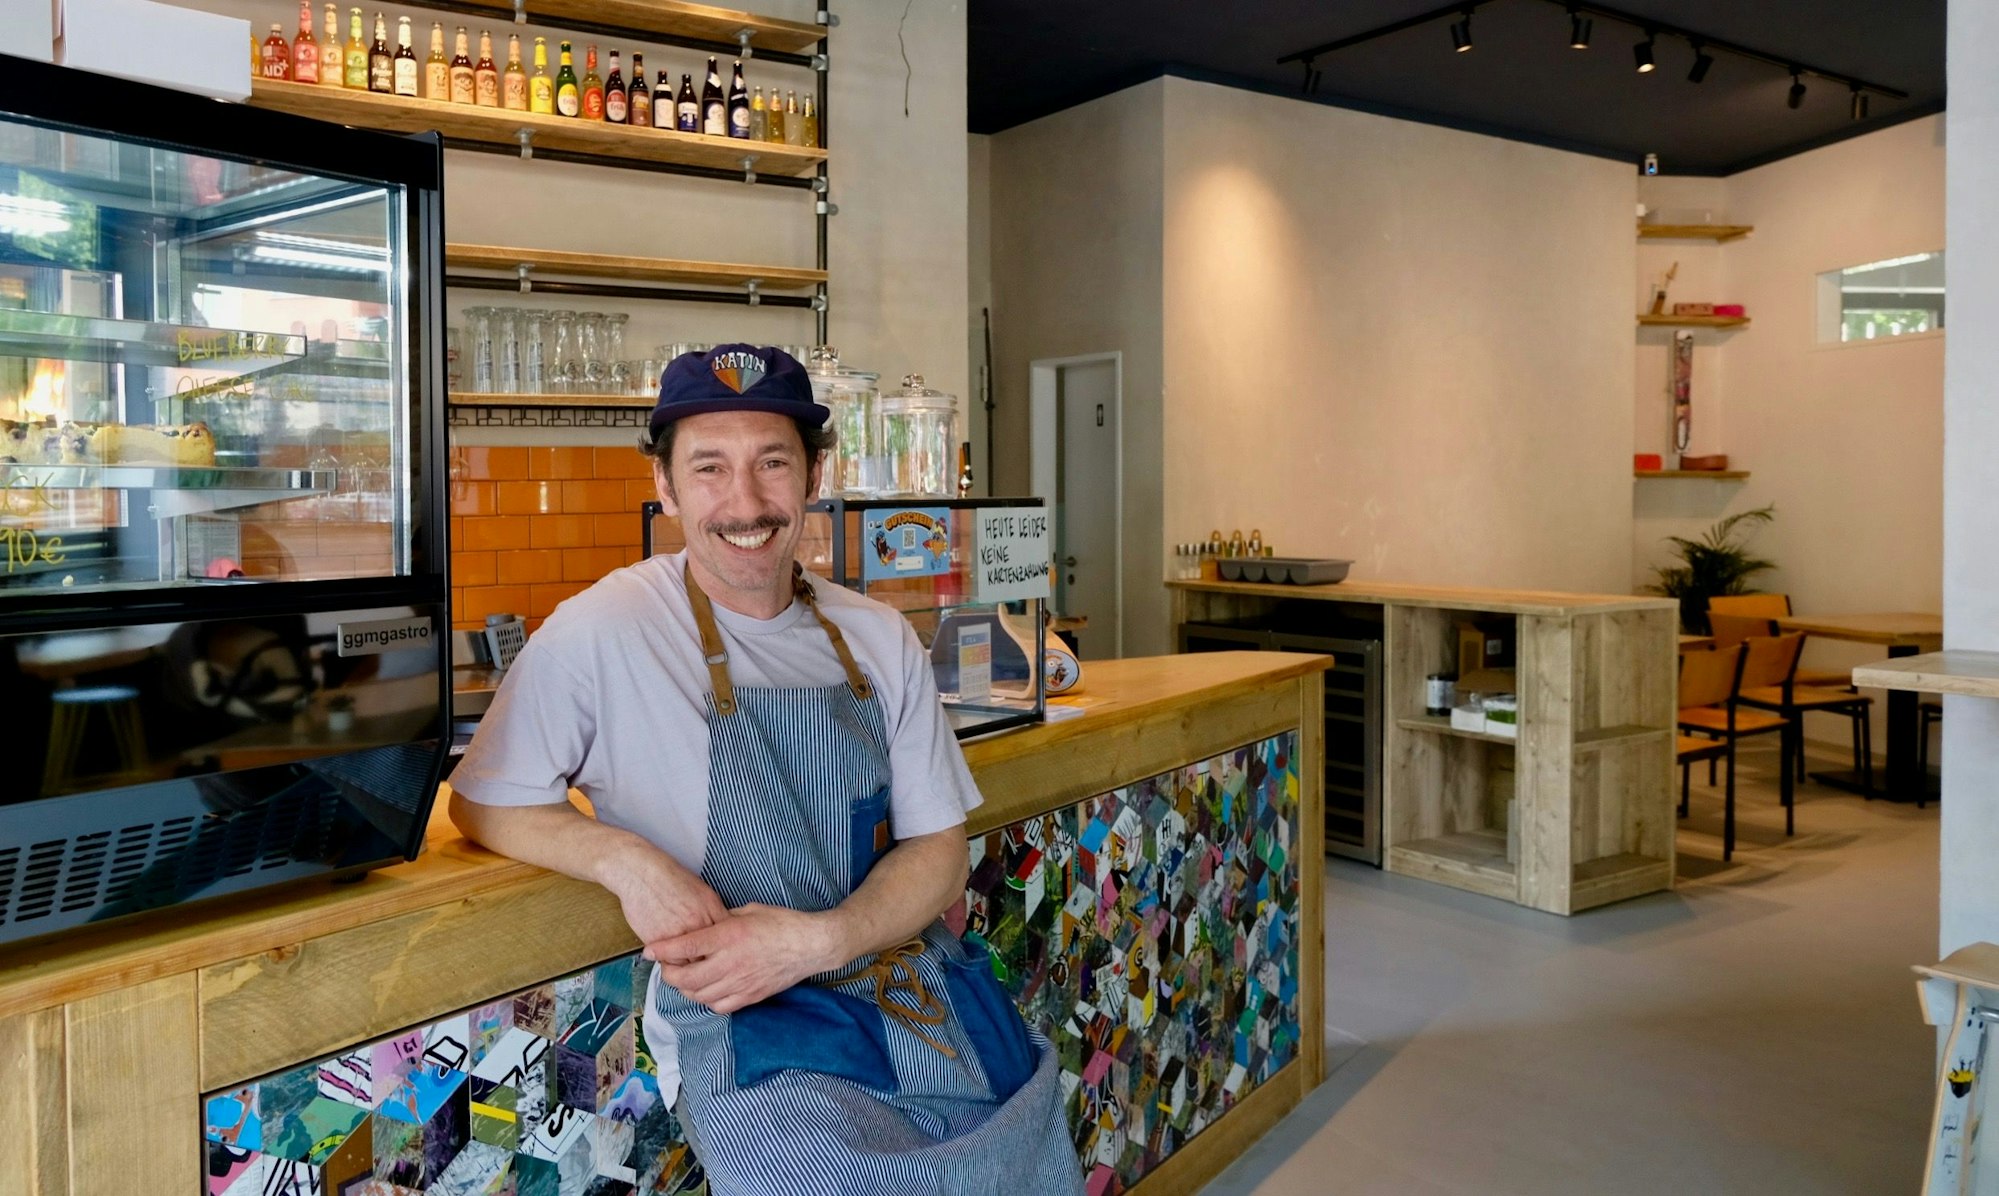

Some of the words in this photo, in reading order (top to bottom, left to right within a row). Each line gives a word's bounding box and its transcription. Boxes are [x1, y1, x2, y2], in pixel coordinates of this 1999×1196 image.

[715, 352, 765, 373] KATIN
[885, 511, 934, 531] GUTSCHEIN
[985, 516, 1014, 539] HEUTE
[987, 561, 1048, 586] KARTENZAHLUNG
[343, 626, 428, 649] ggmgastro
